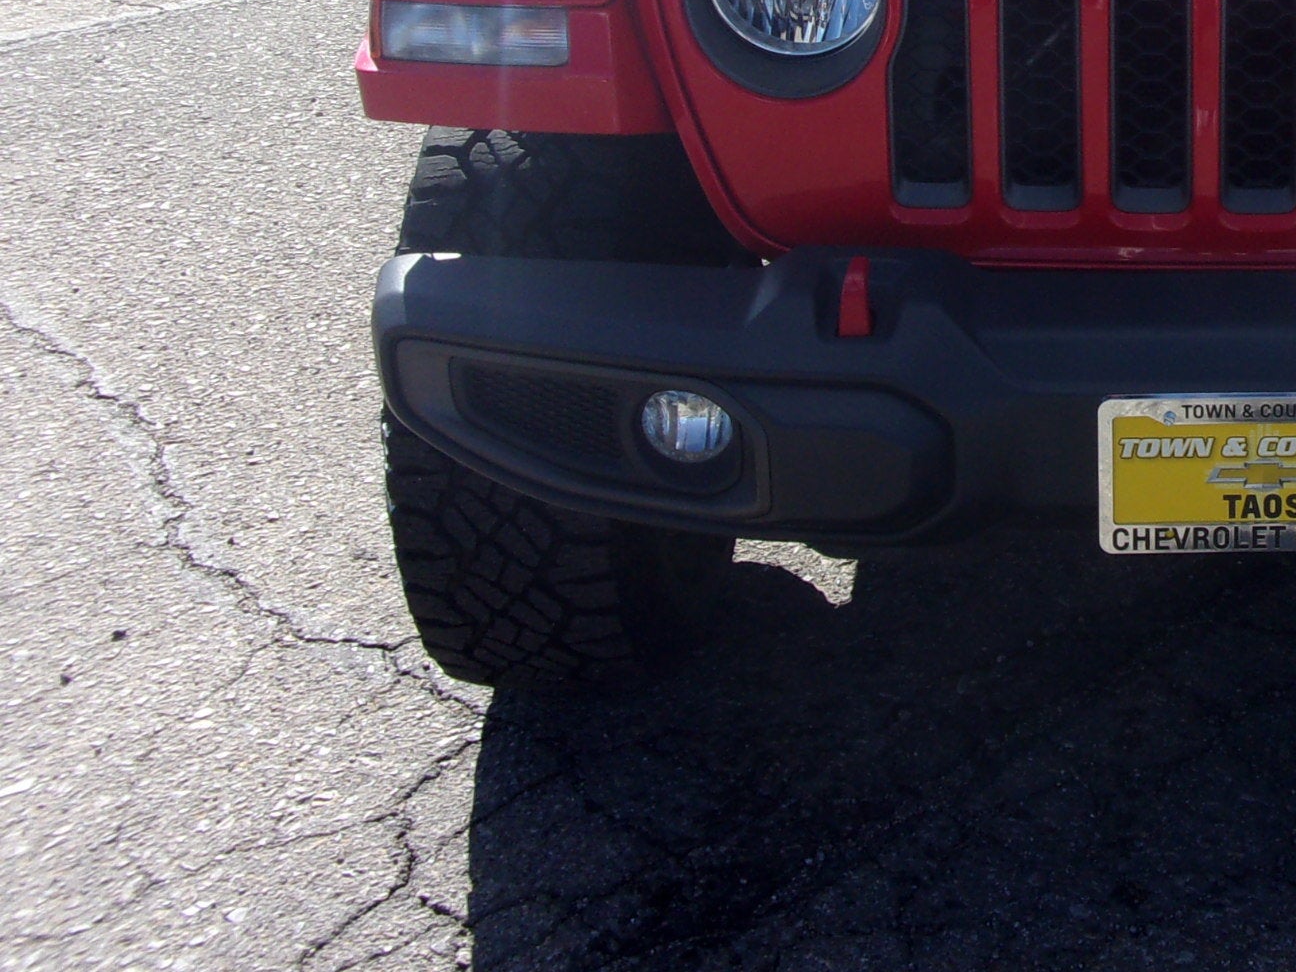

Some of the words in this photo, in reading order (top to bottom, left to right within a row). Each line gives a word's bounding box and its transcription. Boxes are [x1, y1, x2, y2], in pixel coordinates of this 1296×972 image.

[1181, 404, 1236, 419] TOWN
[1242, 403, 1255, 418] &
[1118, 436, 1216, 459] TOWN
[1221, 435, 1249, 457] &
[1111, 526, 1288, 551] CHEVROLET
